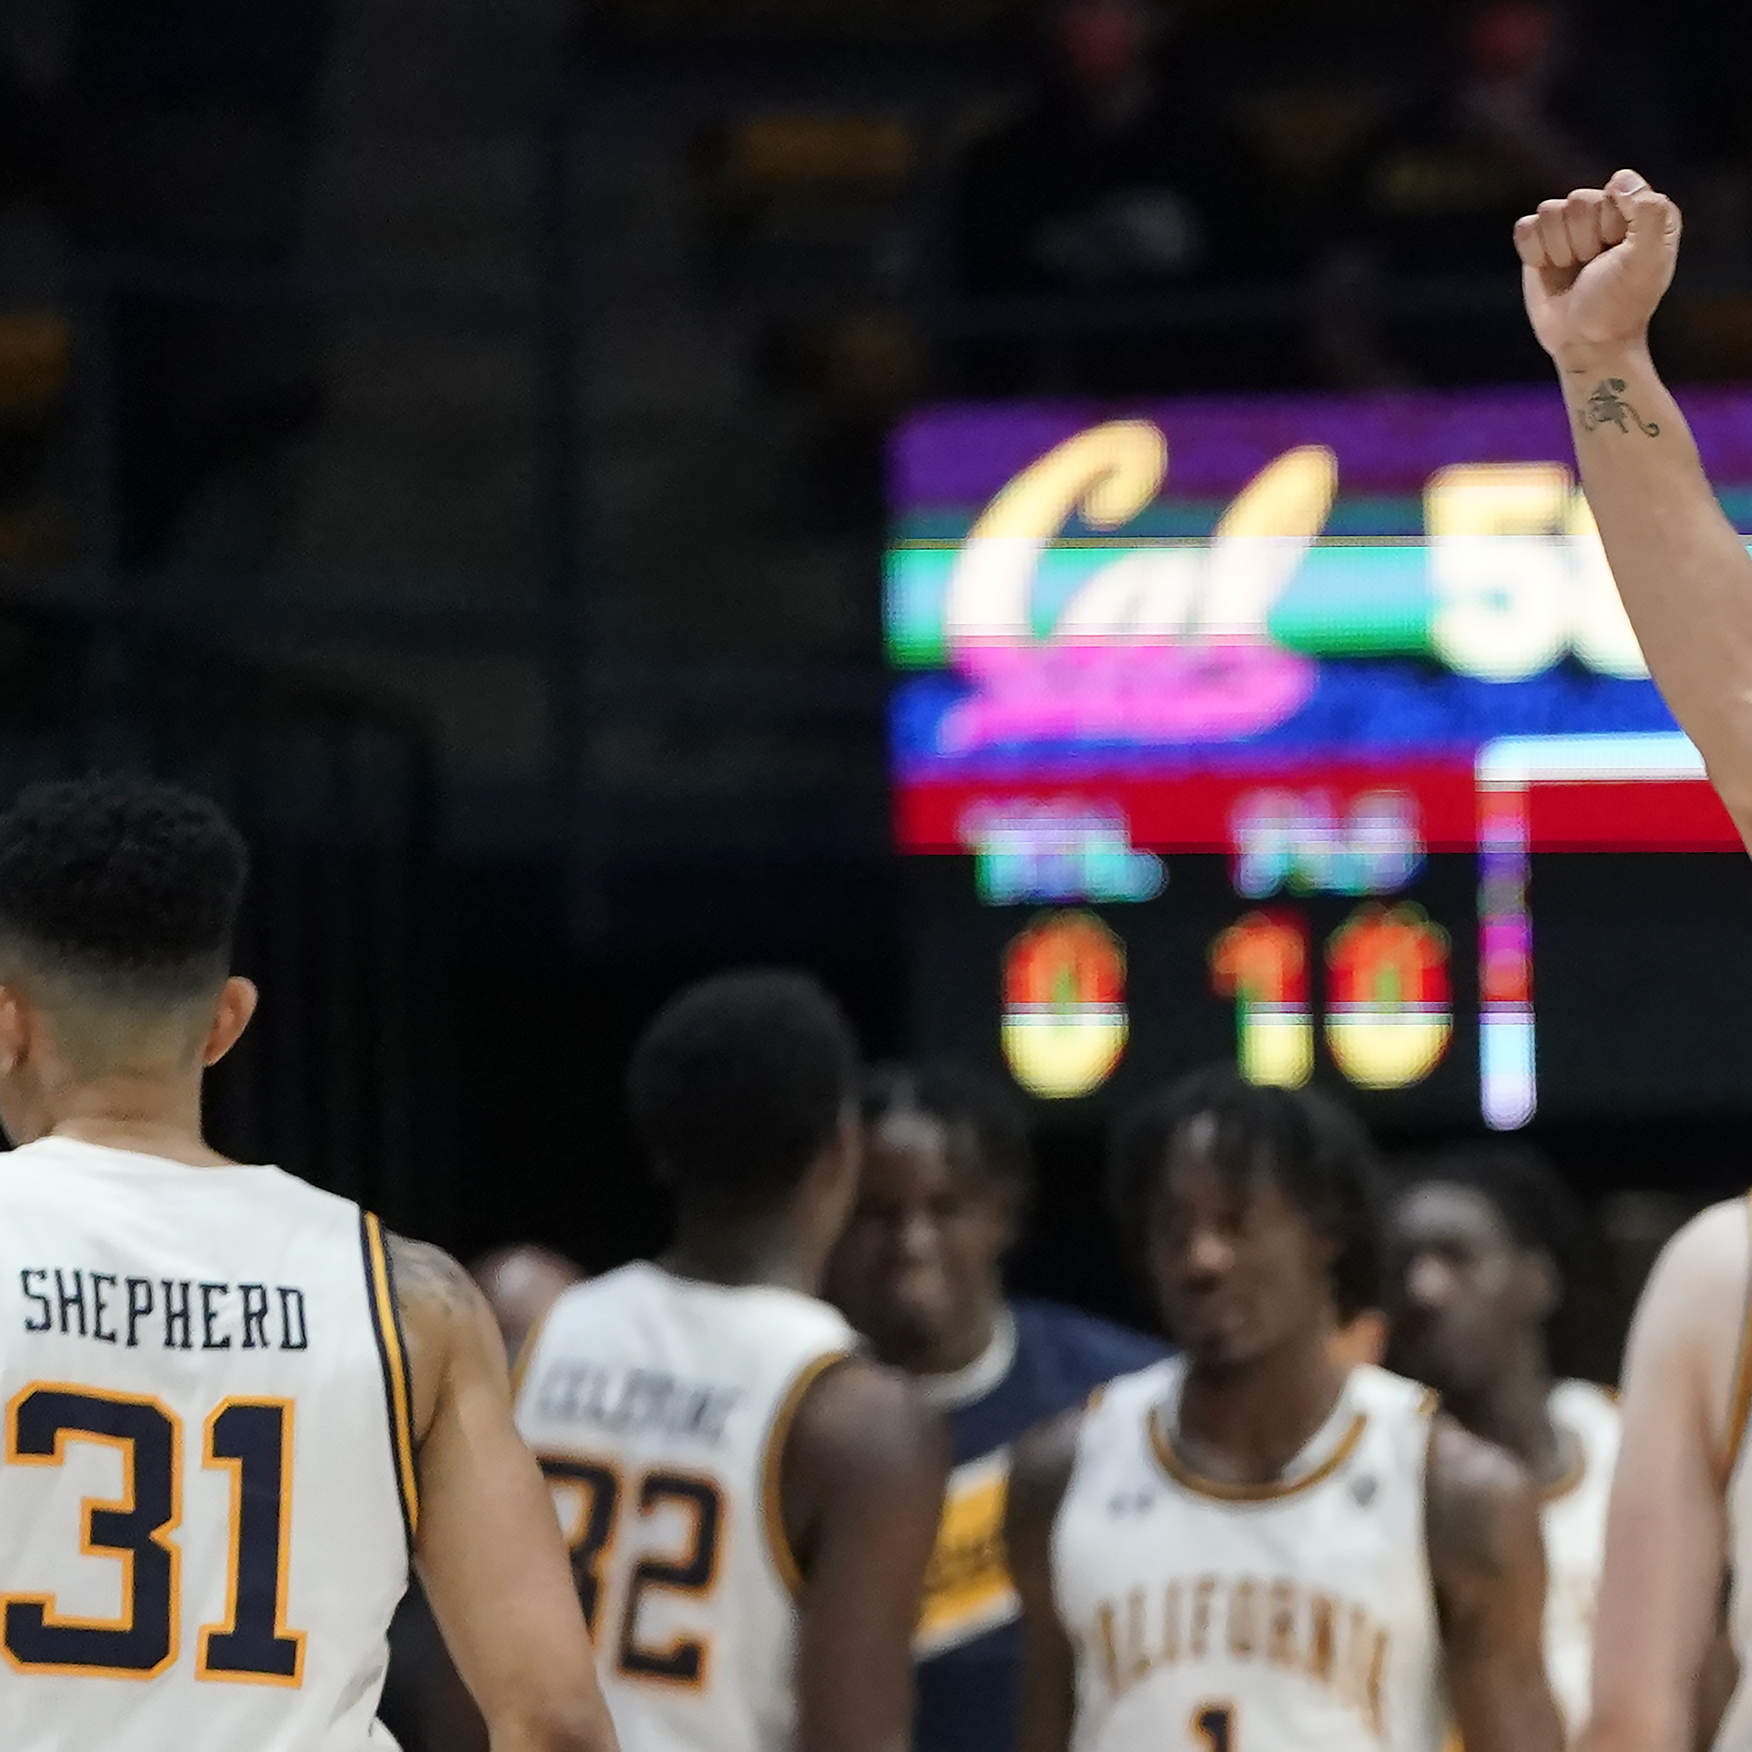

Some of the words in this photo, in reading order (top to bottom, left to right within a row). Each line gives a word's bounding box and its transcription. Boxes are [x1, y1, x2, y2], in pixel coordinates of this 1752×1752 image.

[940, 418, 1340, 752] Cal
[20, 1266, 309, 1352] SHEPHERD
[0, 1379, 308, 1690] 31
